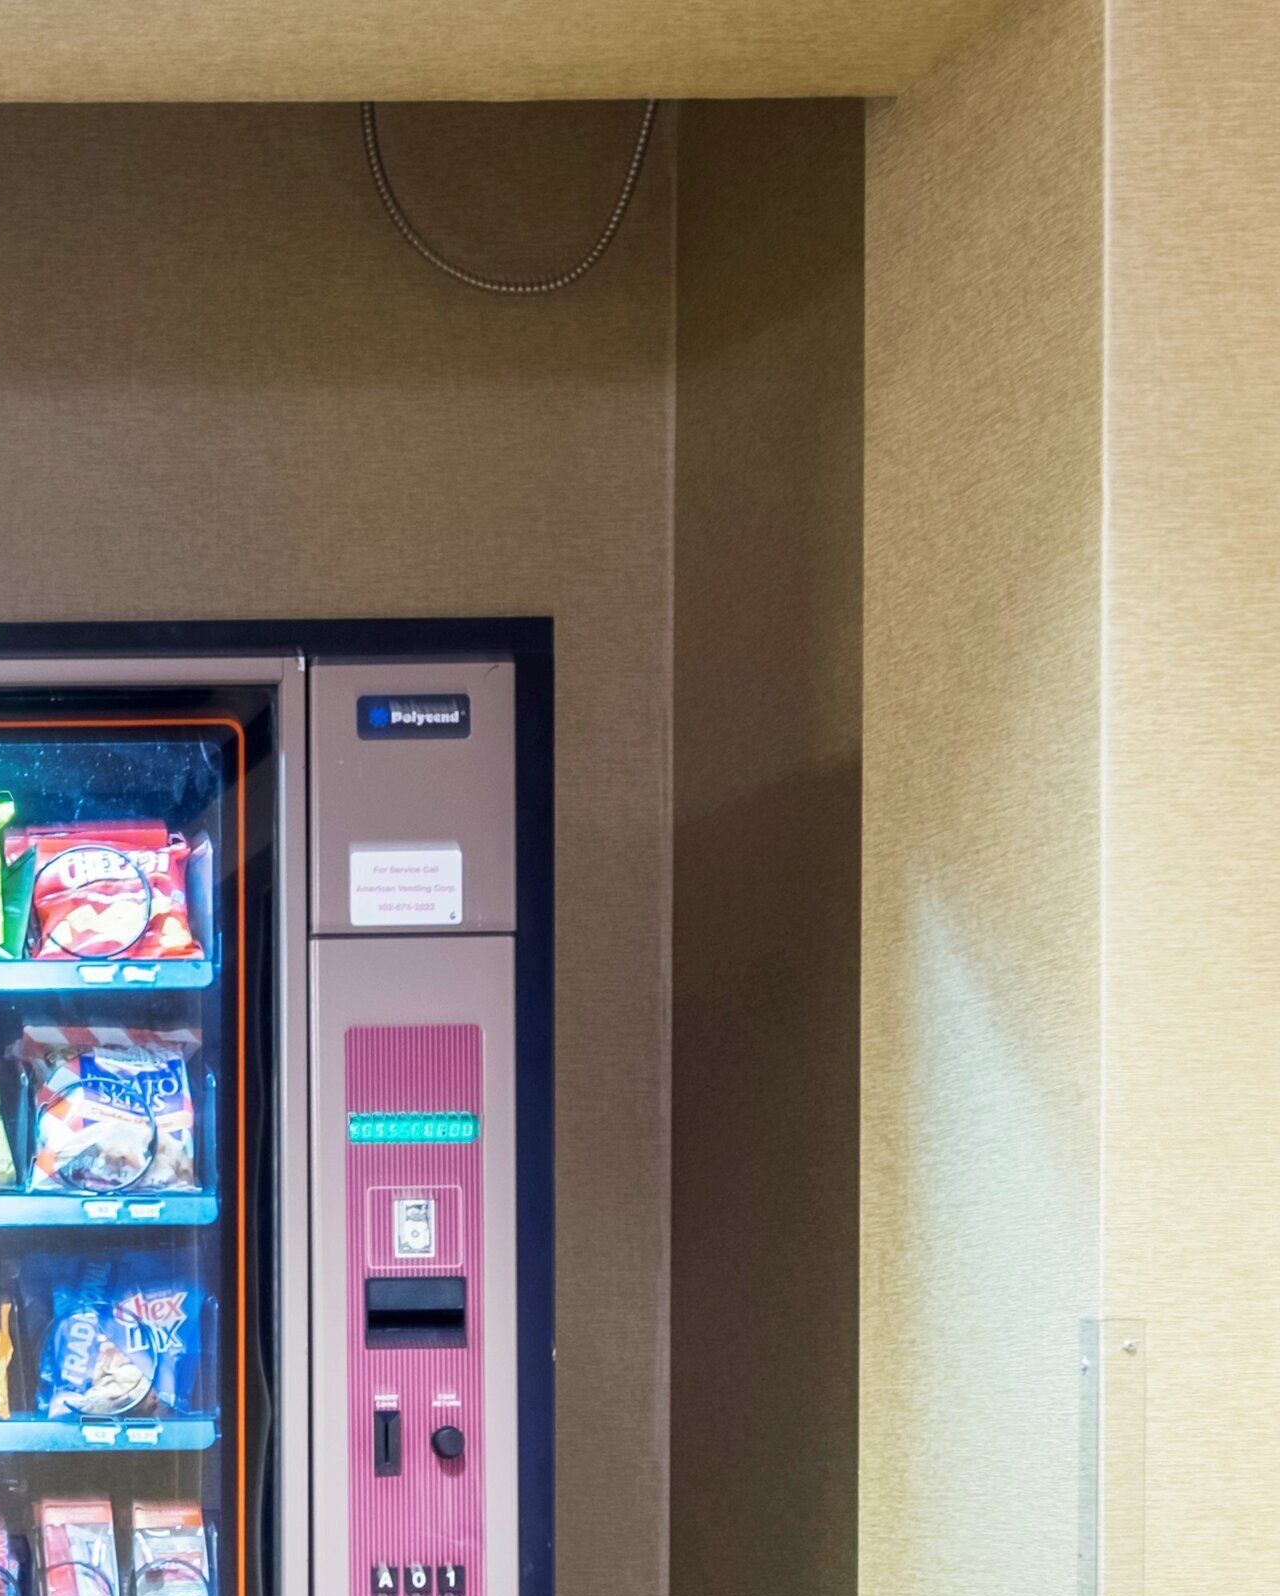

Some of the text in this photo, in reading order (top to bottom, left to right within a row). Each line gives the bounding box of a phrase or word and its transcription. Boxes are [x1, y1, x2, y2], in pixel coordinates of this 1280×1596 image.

[390, 710, 460, 727] Polyvend
[113, 1293, 182, 1325] Chex
[378, 1572, 456, 1588] A 0 1
